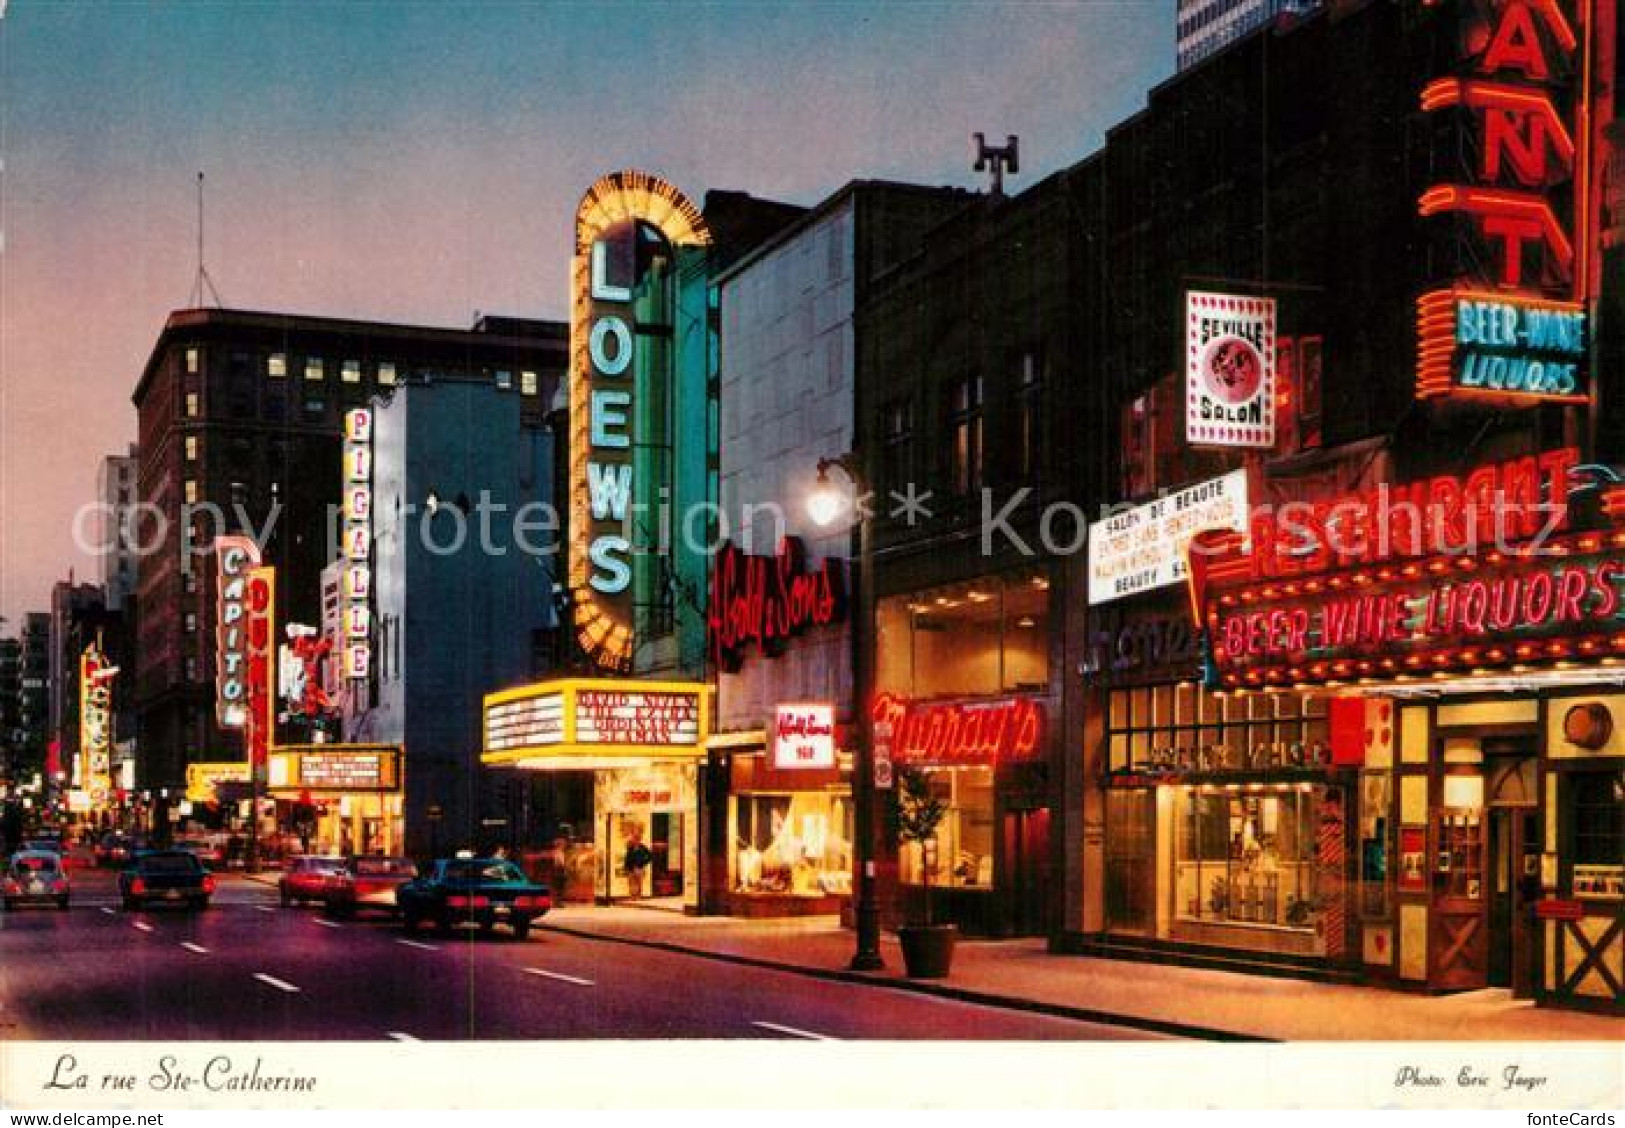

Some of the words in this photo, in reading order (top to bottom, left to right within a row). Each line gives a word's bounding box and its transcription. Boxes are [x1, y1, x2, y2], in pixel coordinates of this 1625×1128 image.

[1202, 318, 1264, 352] SEVILLE
[1461, 353, 1577, 393] LIQUORS
[587, 241, 631, 593] LOEWS
[1202, 395, 1262, 425] SALON
[1106, 512, 1140, 534] SALON
[1151, 501, 1164, 518] DE
[1176, 480, 1223, 511] BEAUTE
[1252, 447, 1580, 577] RESTAURANT
[350, 411, 369, 669] PIGALLE
[1115, 569, 1158, 593] BEAUTY
[1225, 609, 1308, 657] BEER
[1321, 594, 1411, 647] WINE
[1425, 561, 1620, 636] LIQUORS
[579, 692, 628, 706] DAVID
[872, 691, 1040, 766] Murray's
